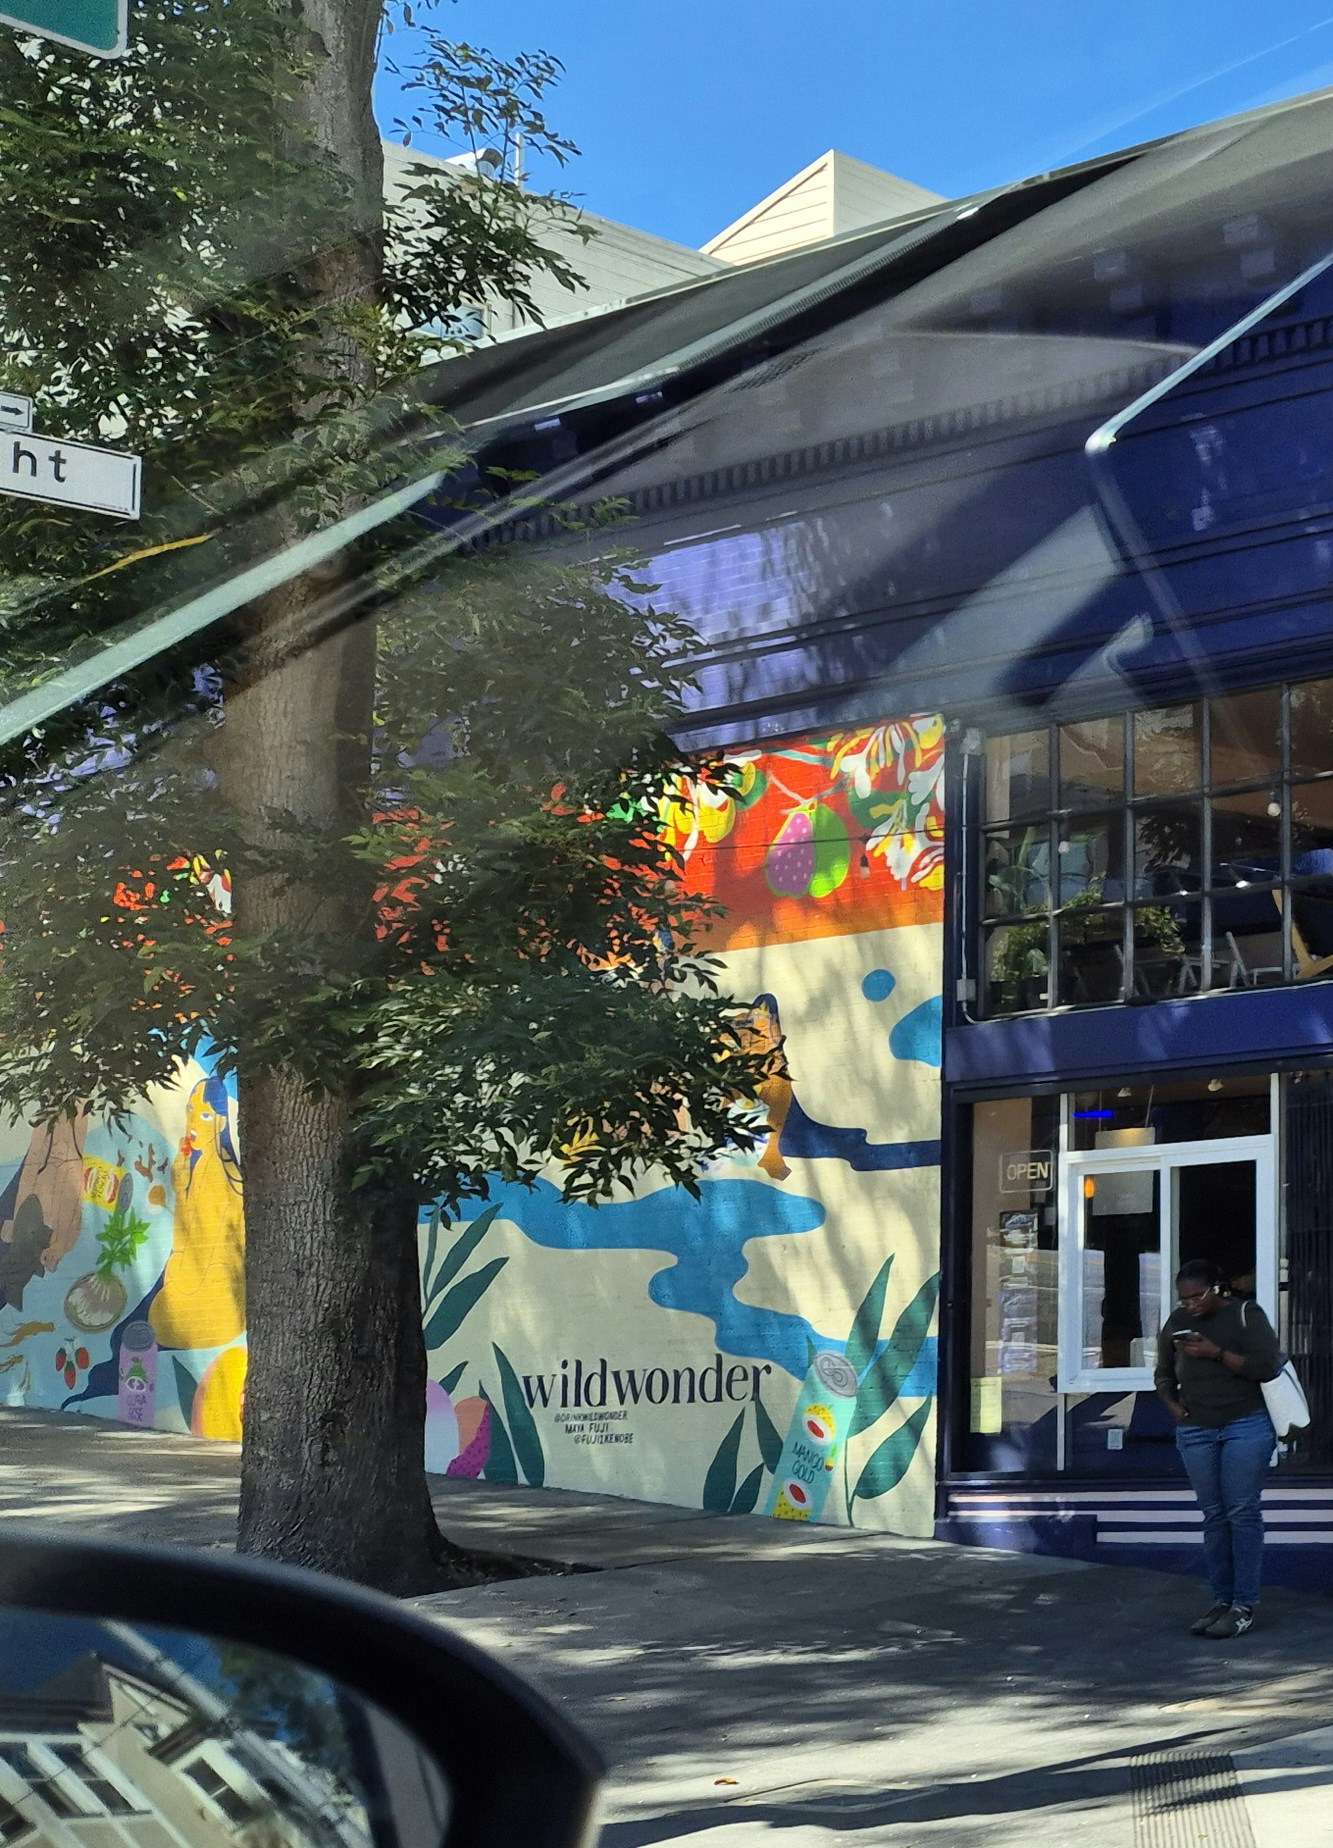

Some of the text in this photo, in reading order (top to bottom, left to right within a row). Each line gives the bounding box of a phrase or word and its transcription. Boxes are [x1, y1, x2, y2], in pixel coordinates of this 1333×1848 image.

[1006, 1161, 1049, 1181] OPEN
[522, 1353, 772, 1409] wildwonder
[588, 1423, 609, 1433] FUJI
[791, 1441, 825, 1472] MANGO
[791, 1460, 815, 1484] GOLD
